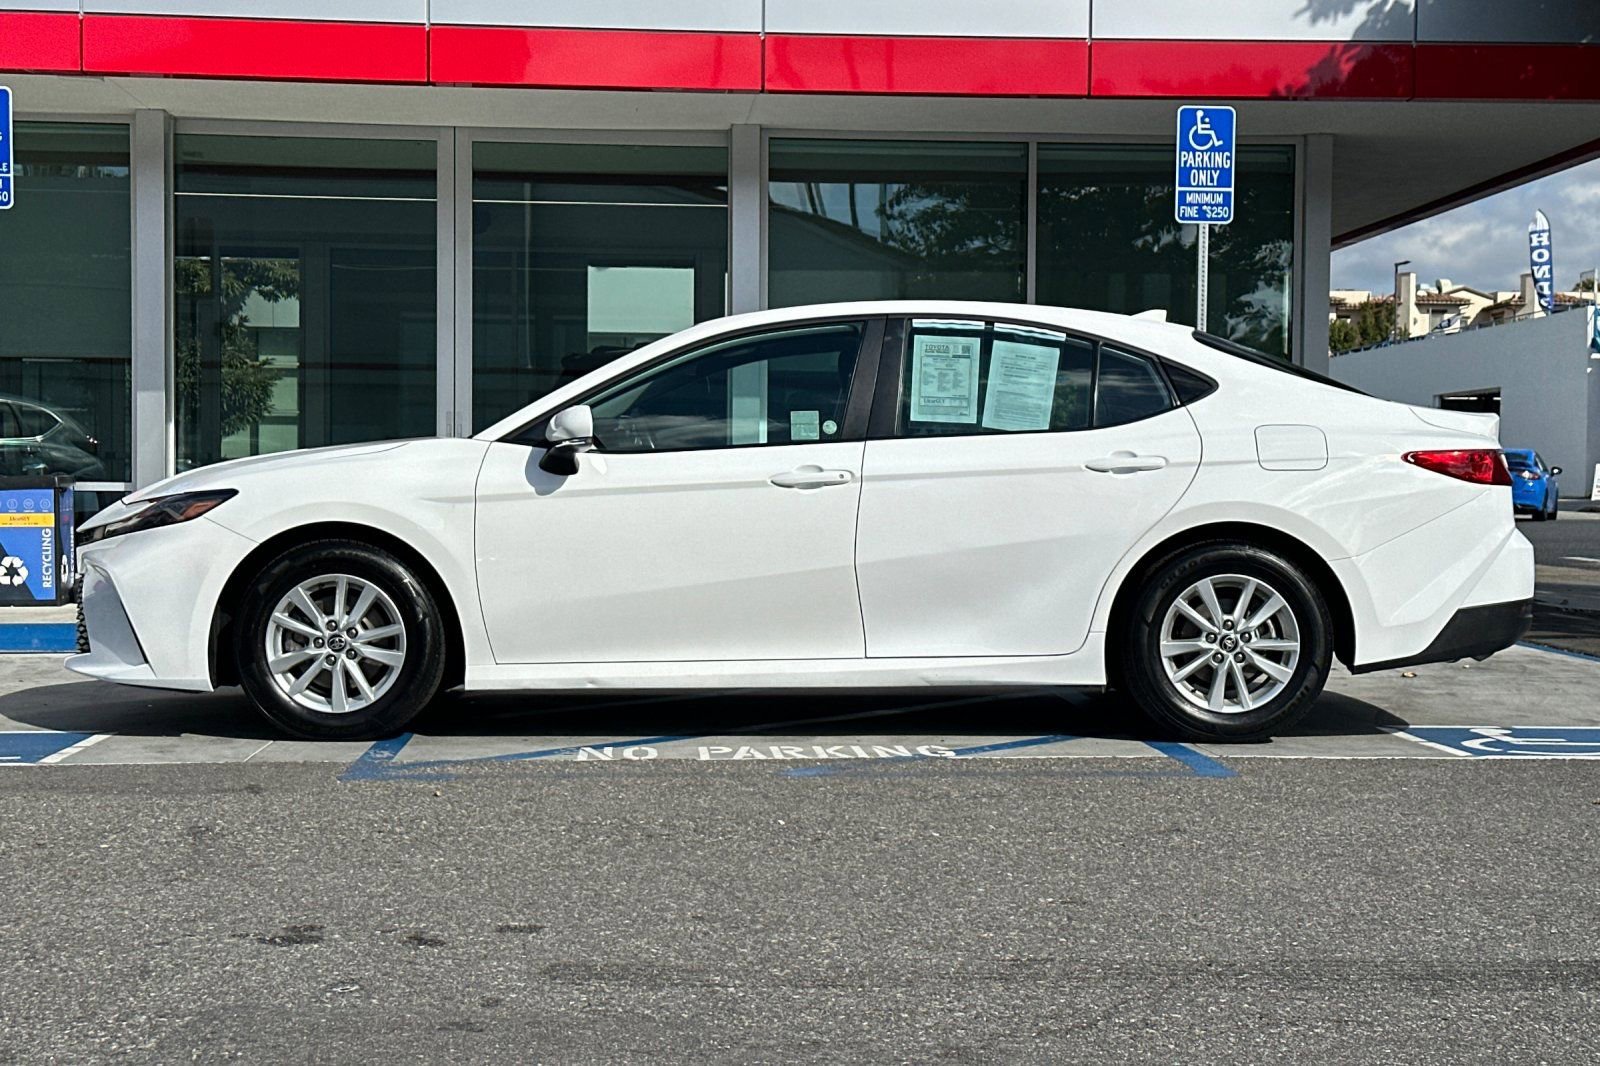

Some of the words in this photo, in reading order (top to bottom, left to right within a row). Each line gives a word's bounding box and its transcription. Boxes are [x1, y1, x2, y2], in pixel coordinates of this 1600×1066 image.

[1180, 151, 1231, 169] PARKING
[1190, 169, 1220, 186] ONLY
[1186, 192, 1223, 204] MINIMUM
[1179, 206, 1199, 218] FINE
[1205, 206, 1229, 218] $250
[42, 528, 52, 588] RECYCLING
[577, 746, 658, 761] NO
[697, 745, 956, 761] PARKING
